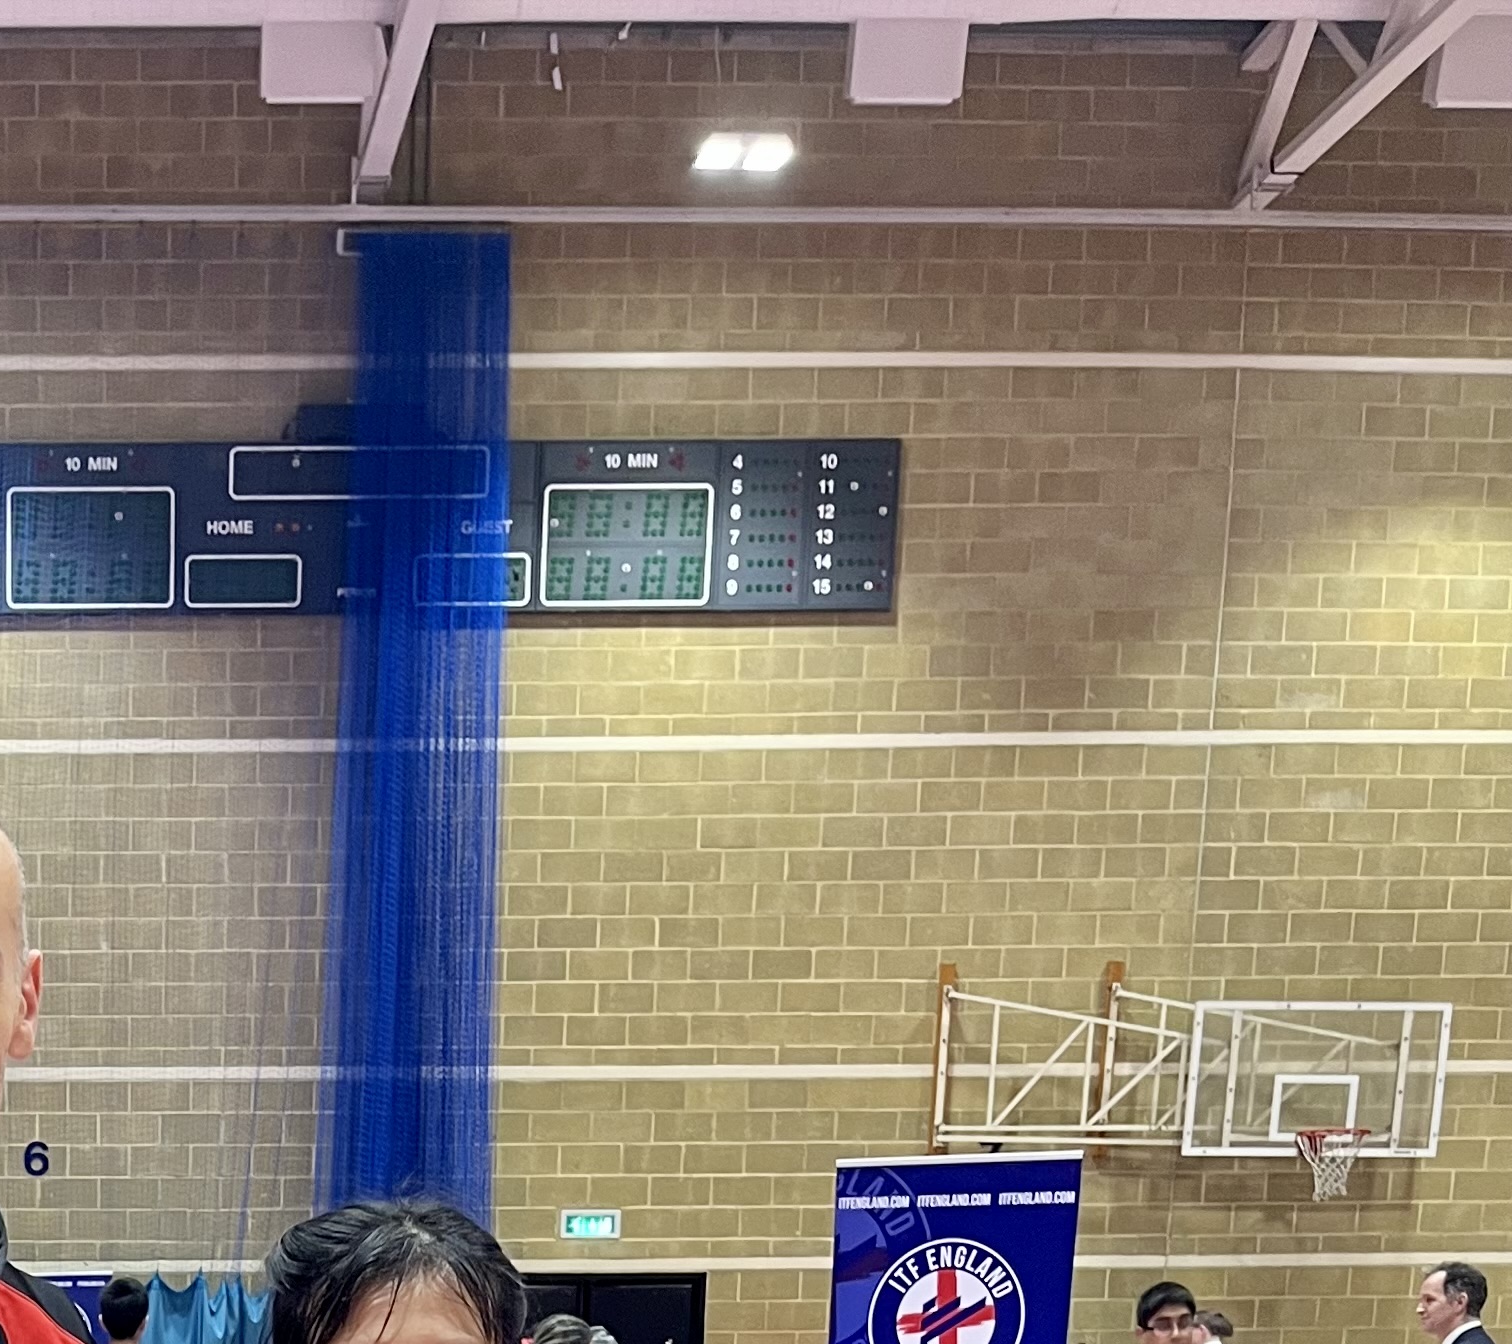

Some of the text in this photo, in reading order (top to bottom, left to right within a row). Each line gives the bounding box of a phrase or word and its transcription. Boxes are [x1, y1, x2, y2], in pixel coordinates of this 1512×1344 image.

[65, 456, 118, 471] 10 MIN
[604, 453, 658, 469] 10 MIN
[733, 454, 743, 470] 4
[820, 453, 838, 469] 10
[732, 479, 743, 495] 5
[818, 479, 835, 494] 11
[730, 504, 742, 520] 6
[817, 504, 835, 519] 12
[206, 520, 254, 535] HOME
[729, 529, 740, 546] 7
[816, 529, 834, 544] 13
[727, 554, 739, 571] 8
[814, 554, 832, 570] 14
[726, 579, 738, 596] 9
[812, 579, 831, 595] 15
[24, 1141, 49, 1176] 6
[838, 1191, 1076, 1209] ITFENGLAND.COM ITFENGLAND.COM ITFENGLAND.COM
[888, 1245, 1013, 1299] ITF ENGLAND
